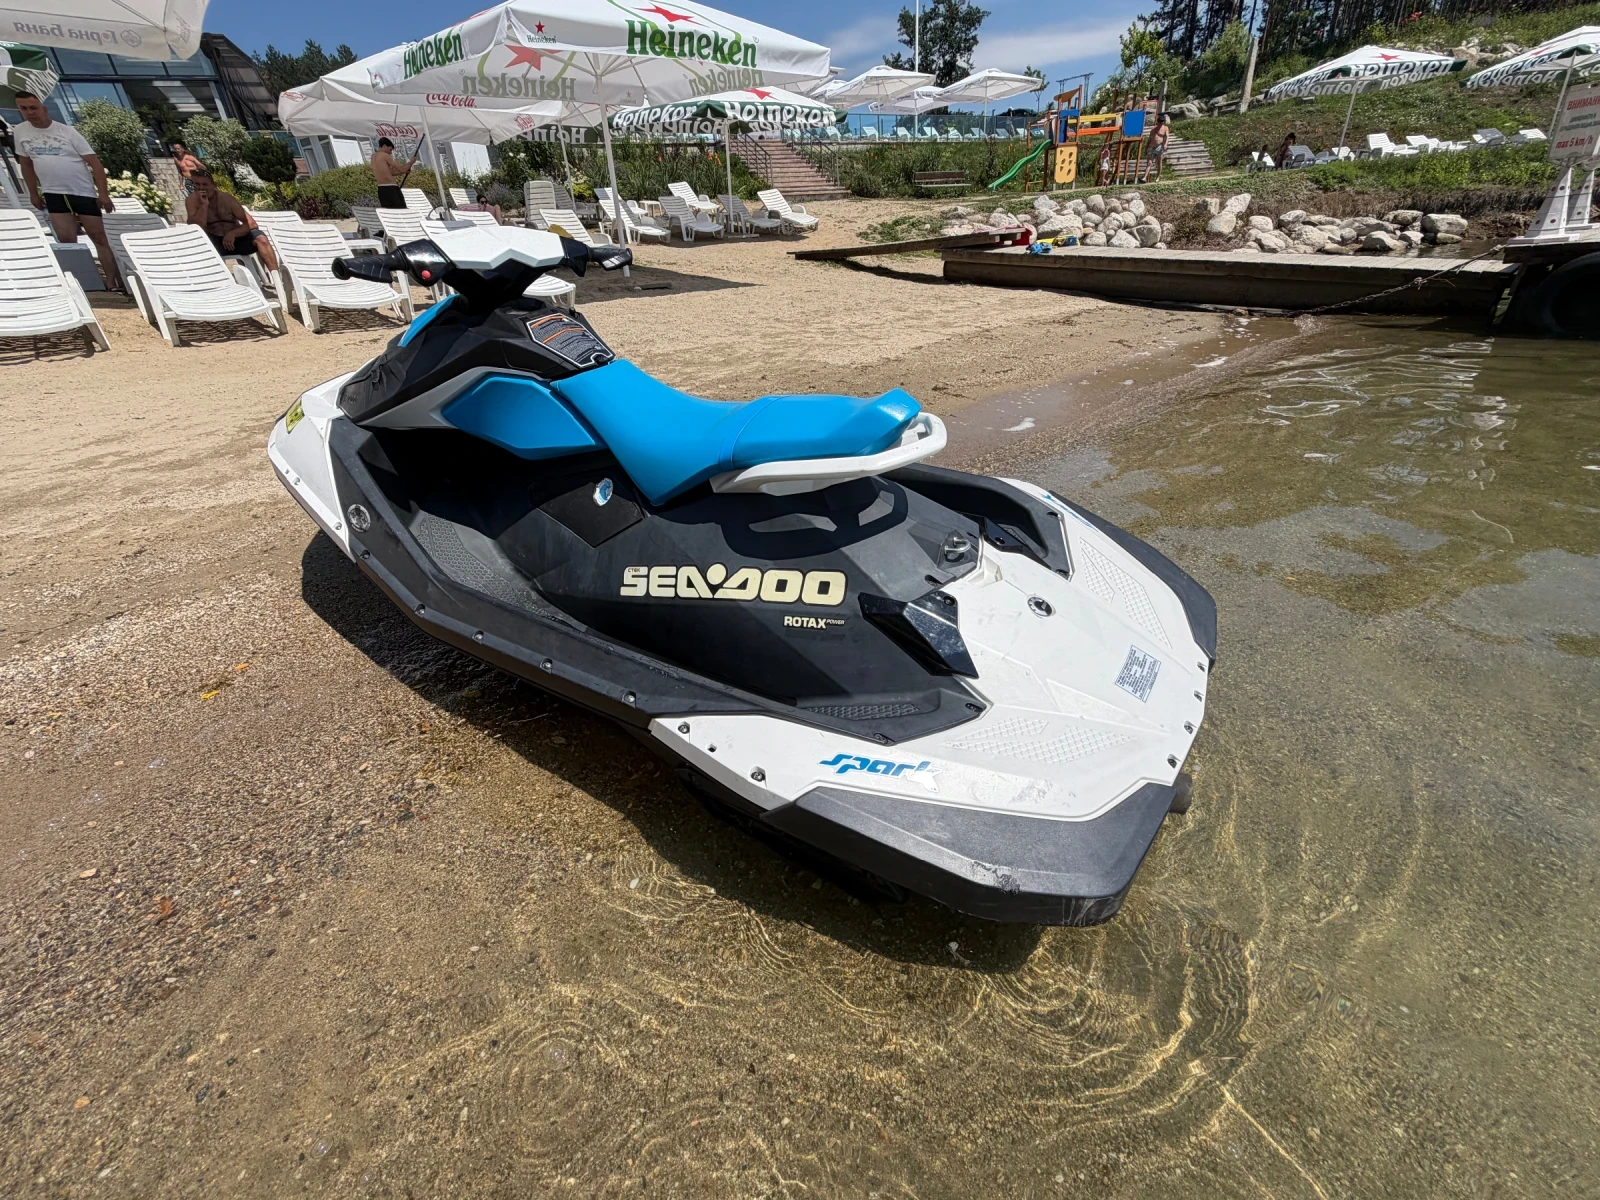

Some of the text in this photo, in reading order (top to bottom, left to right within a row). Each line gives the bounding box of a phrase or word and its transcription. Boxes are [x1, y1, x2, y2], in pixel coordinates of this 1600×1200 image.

[624, 19, 757, 68] Heineken
[403, 33, 464, 80] Heineken
[1350, 60, 1454, 78] Heineken
[722, 101, 837, 126] Heineken
[1569, 137, 1575, 147] 5
[784, 616, 827, 629] ROTAX
